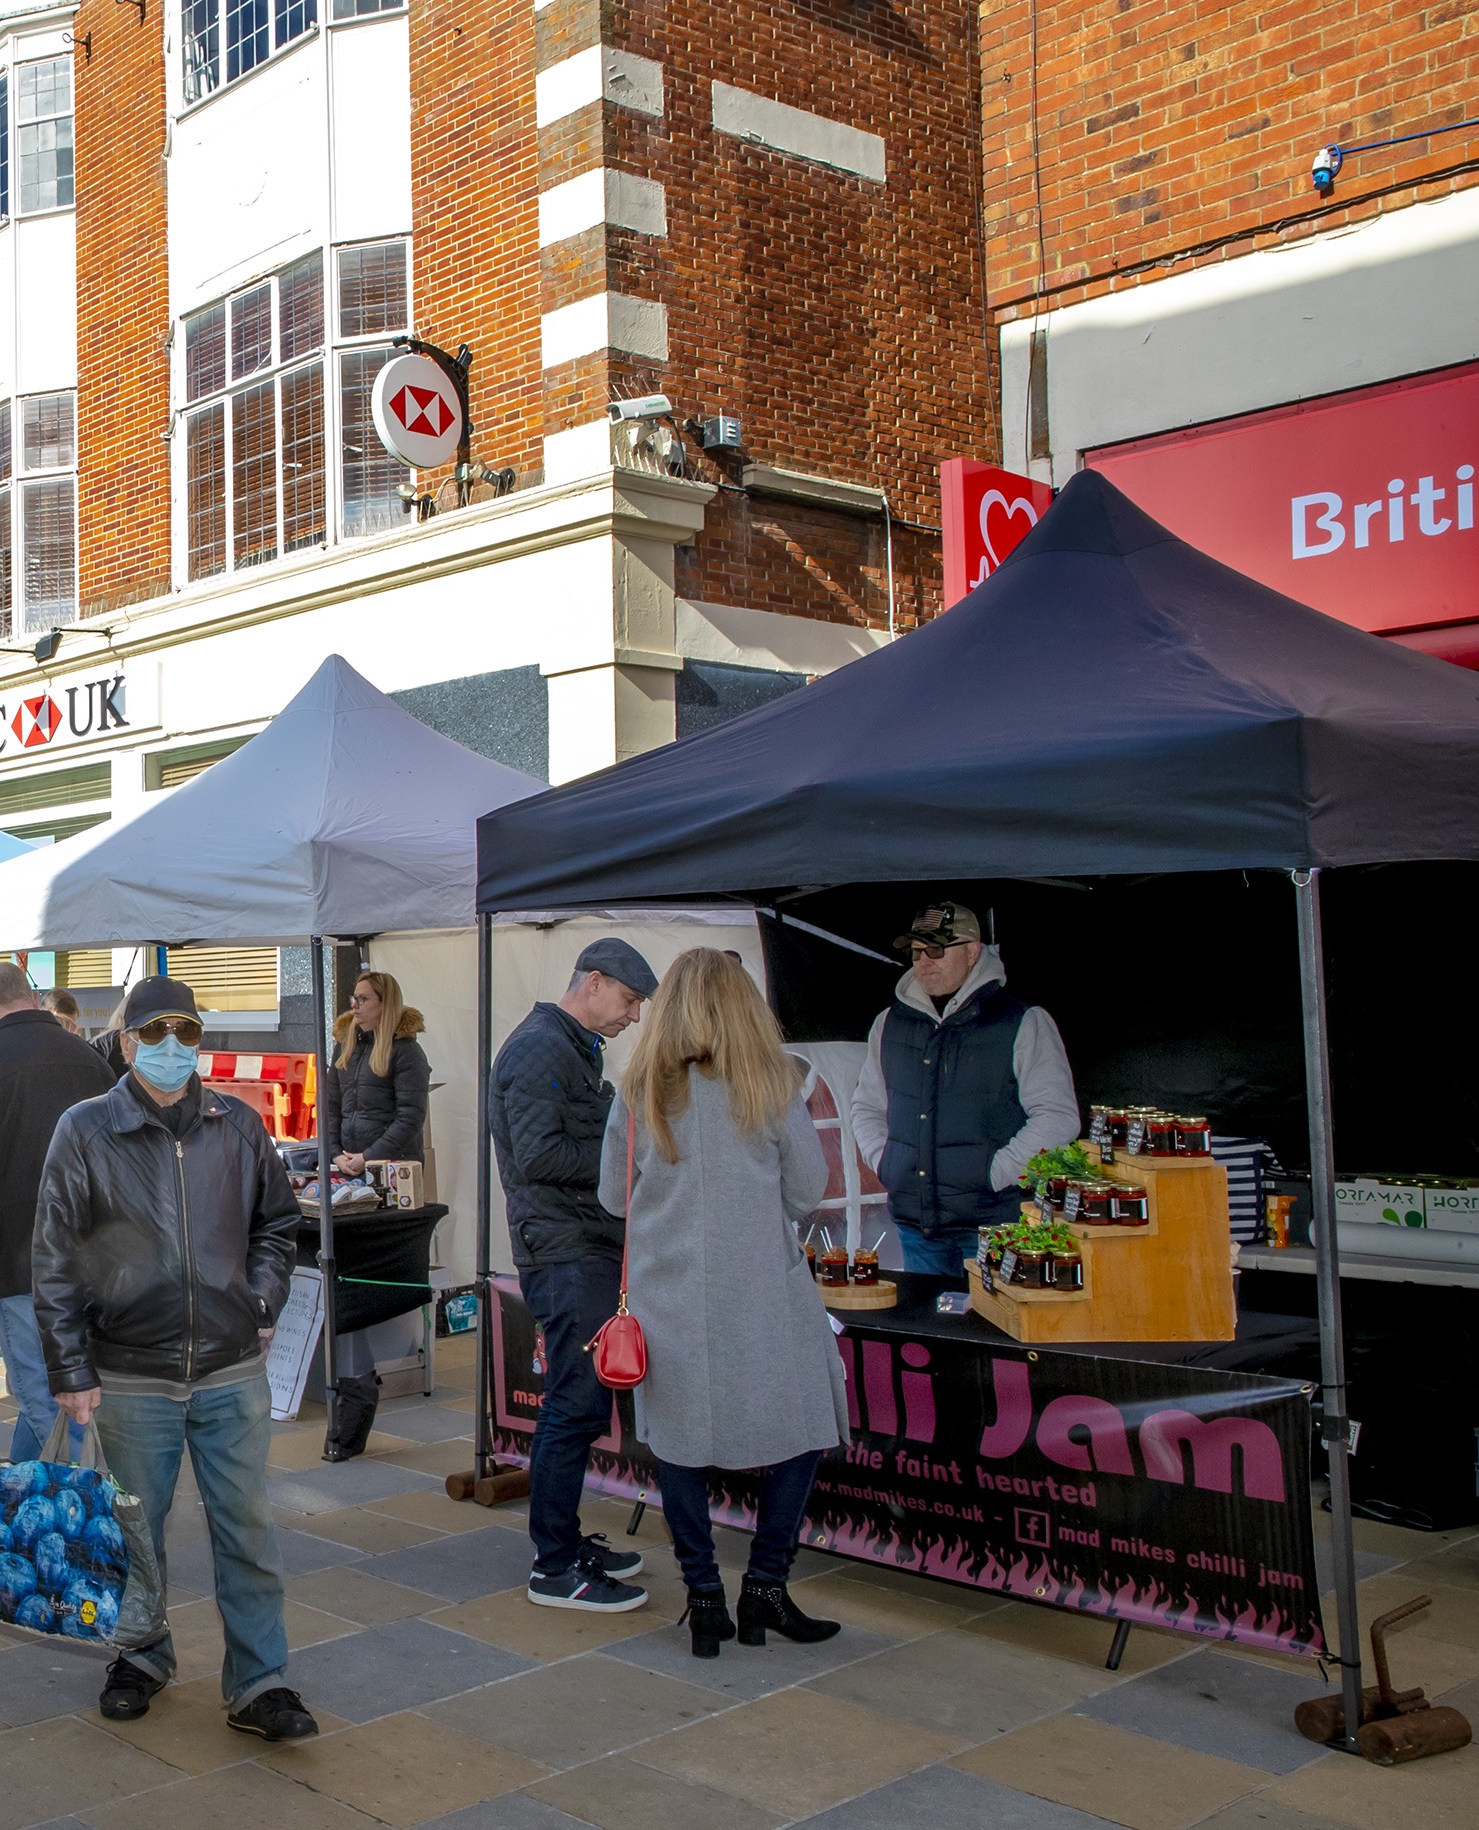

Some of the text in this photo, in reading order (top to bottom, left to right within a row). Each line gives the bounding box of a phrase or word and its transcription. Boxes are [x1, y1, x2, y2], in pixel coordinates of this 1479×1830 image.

[65, 675, 130, 737] UK
[1335, 1188, 1415, 1205] ORTAMAR
[270, 1381, 293, 1394] SIONS
[979, 1357, 1286, 1503] Jam
[845, 1439, 1097, 1508] the faint hearted
[1058, 1523, 1304, 1591] mad mikes chilli jam
